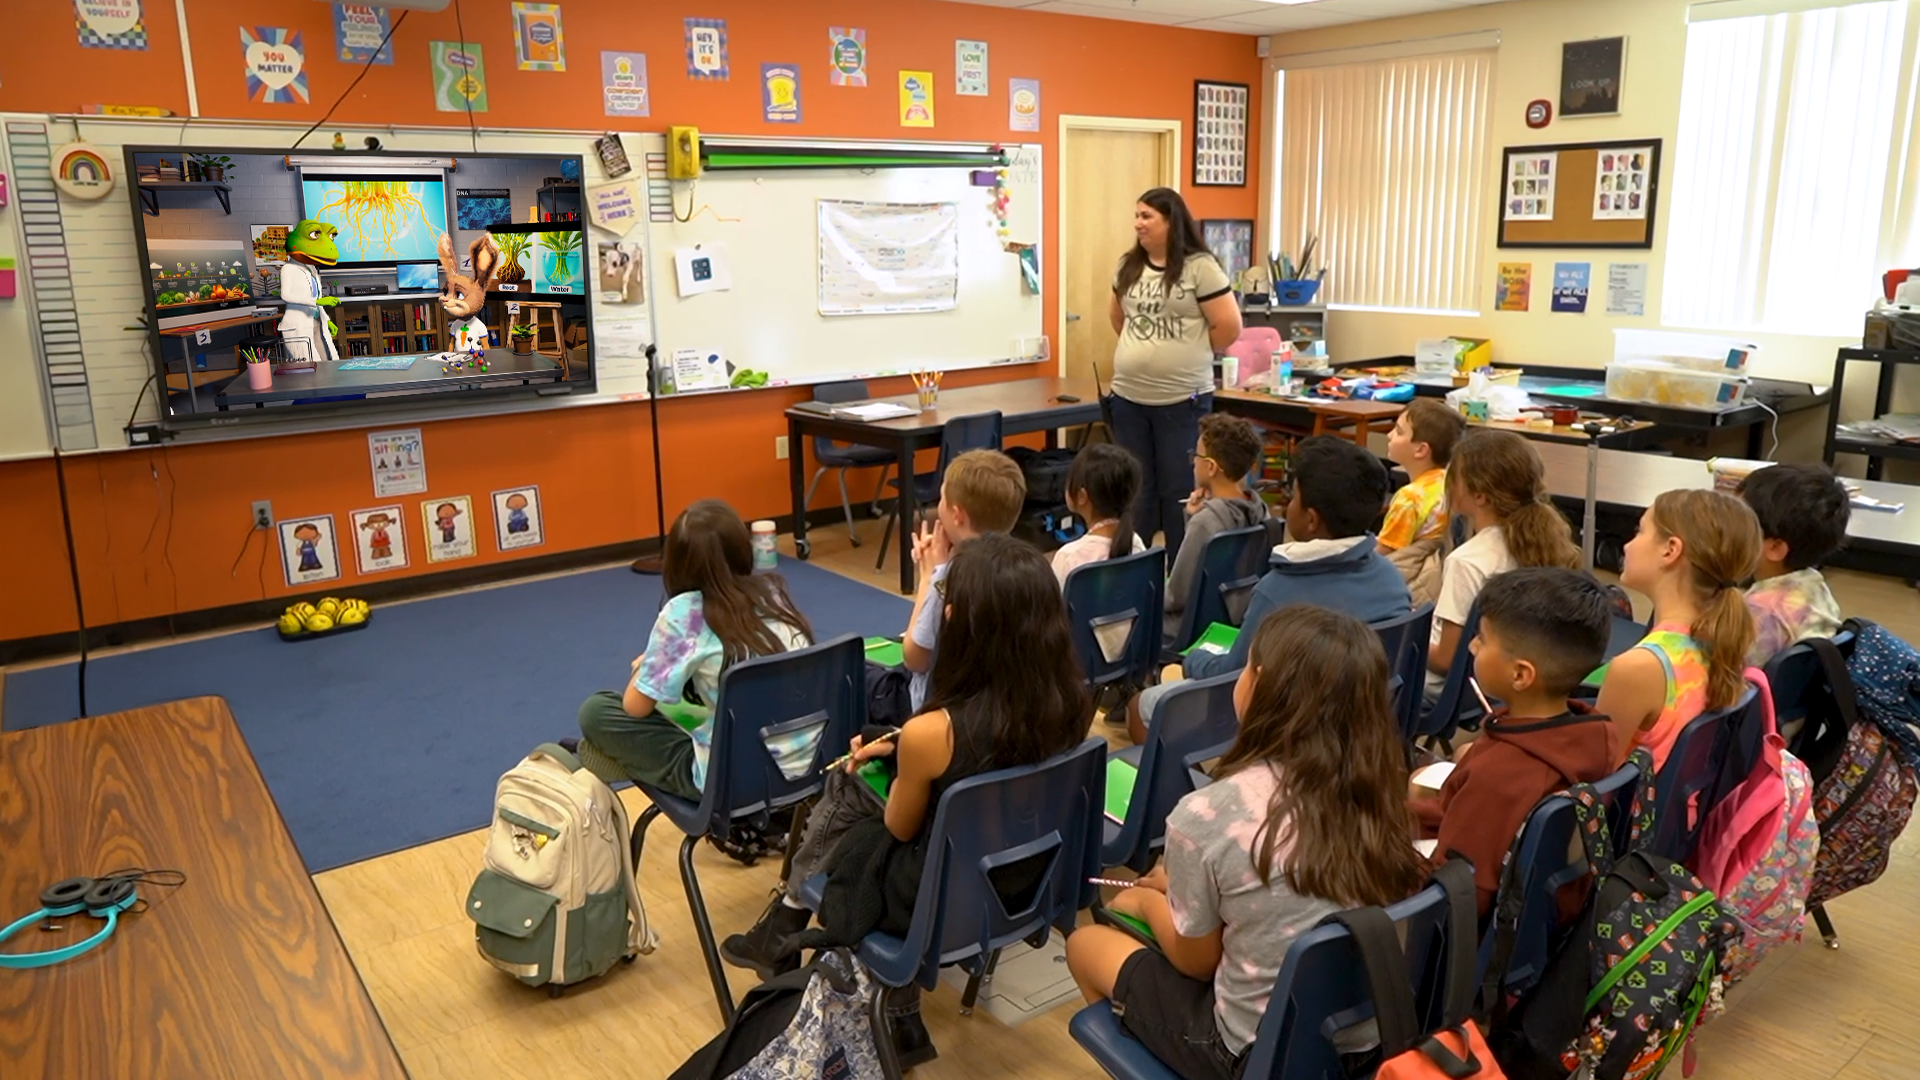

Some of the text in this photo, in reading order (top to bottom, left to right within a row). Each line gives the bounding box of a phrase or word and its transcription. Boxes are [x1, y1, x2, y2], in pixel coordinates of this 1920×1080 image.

[86, 8, 130, 18] YOURSELF
[263, 52, 285, 62] YOU
[962, 54, 981, 63] LOVE
[258, 64, 293, 73] MATTER
[1570, 79, 1611, 89] LOOK UP
[598, 199, 631, 210] WELCOME
[1137, 301, 1166, 314] on
[374, 440, 420, 454] sitting?
[383, 473, 406, 482] check
[453, 540, 469, 548] your
[375, 559, 390, 567] look
